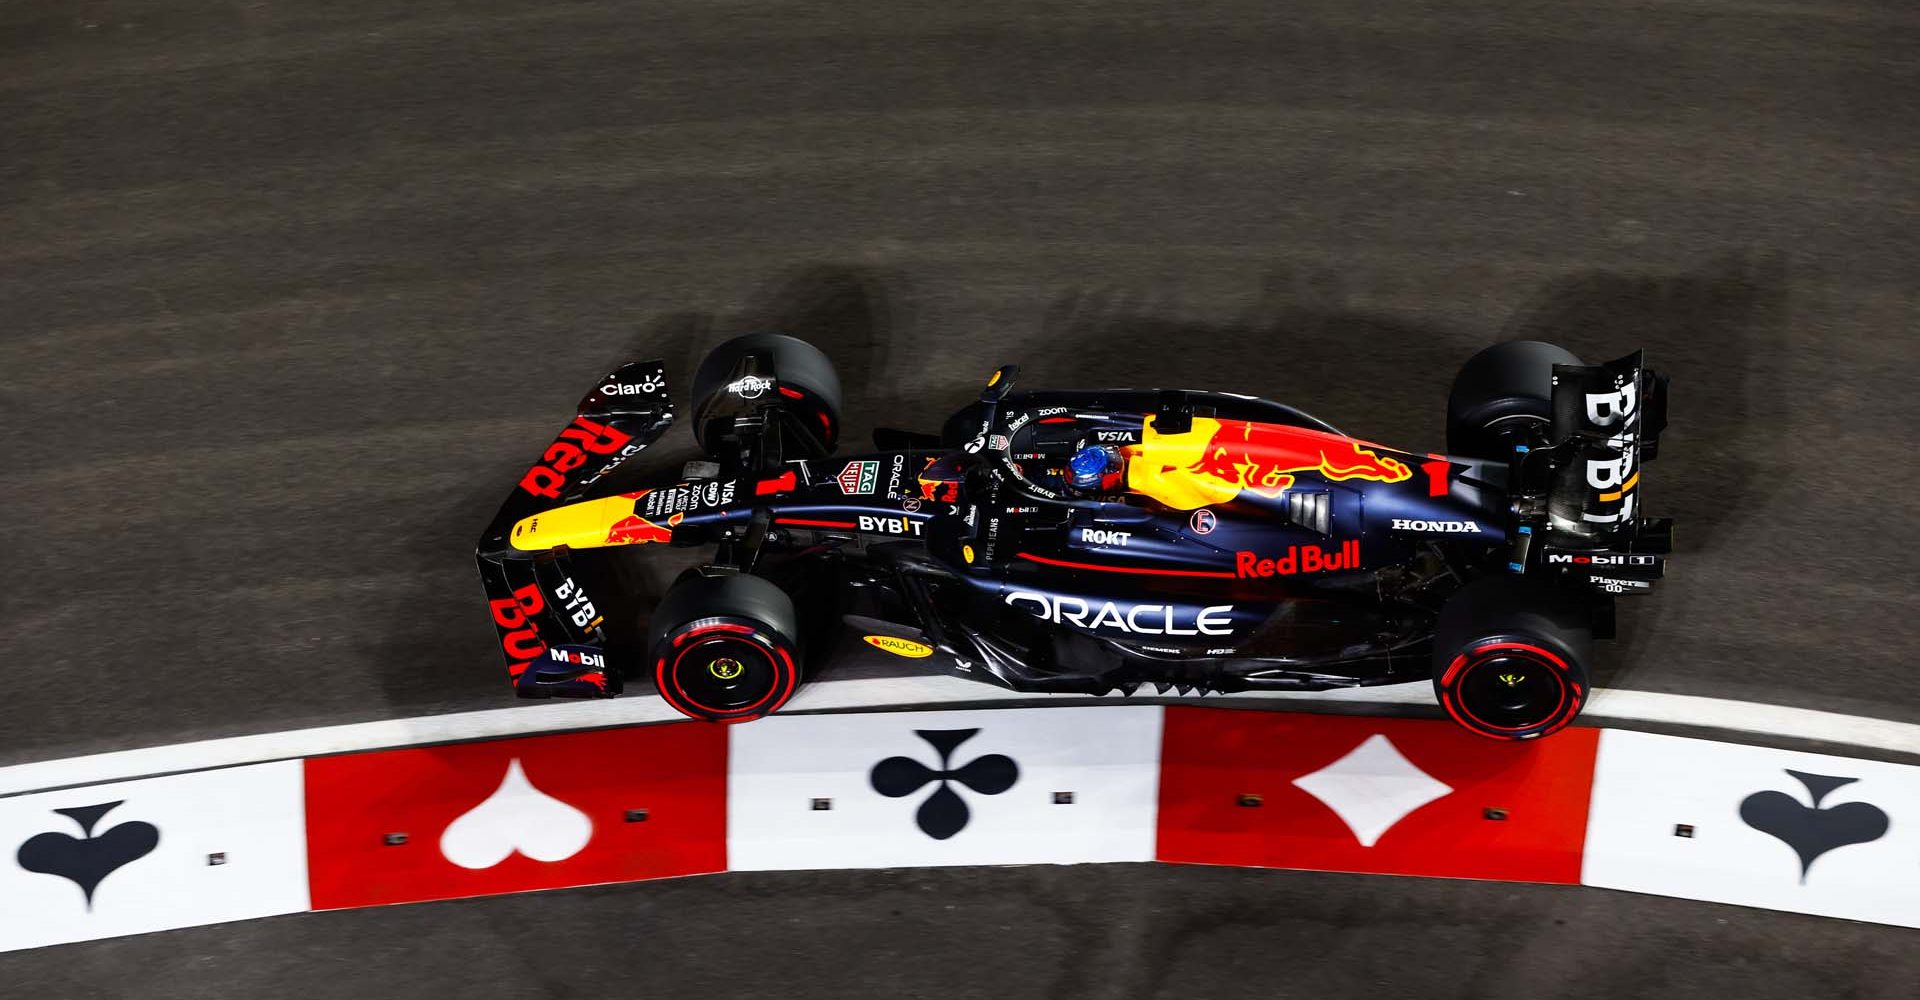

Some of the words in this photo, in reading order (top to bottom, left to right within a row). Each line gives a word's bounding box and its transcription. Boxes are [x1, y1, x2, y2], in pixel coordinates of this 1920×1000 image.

[601, 380, 656, 396] Claro
[728, 381, 750, 392] Hard
[750, 379, 772, 392] Rock
[1008, 412, 1030, 431] telcel
[1038, 406, 1068, 416] zoom
[1097, 431, 1136, 442] VISA
[518, 415, 633, 499] Red
[755, 469, 797, 496] 1
[841, 462, 859, 493] HEUER
[860, 463, 876, 492] TAG
[887, 454, 904, 499] ORACLE
[1420, 459, 1451, 498] 1
[646, 491, 658, 511] Mobil
[689, 484, 702, 511] zoom
[707, 481, 719, 501] CDW
[720, 479, 737, 505] VISA
[859, 516, 924, 536] BYBIT
[988, 518, 999, 540] JEANS
[1391, 518, 1482, 534] HONDA
[1081, 528, 1131, 547] ROKT
[1235, 546, 1298, 580] Red
[1300, 539, 1361, 574] Bull
[1549, 554, 1624, 565] Mobil
[1004, 592, 1234, 637] ORACLE
[489, 582, 548, 688] Bu
[880, 639, 924, 653] RAUCH
[550, 647, 606, 668] Mobil
